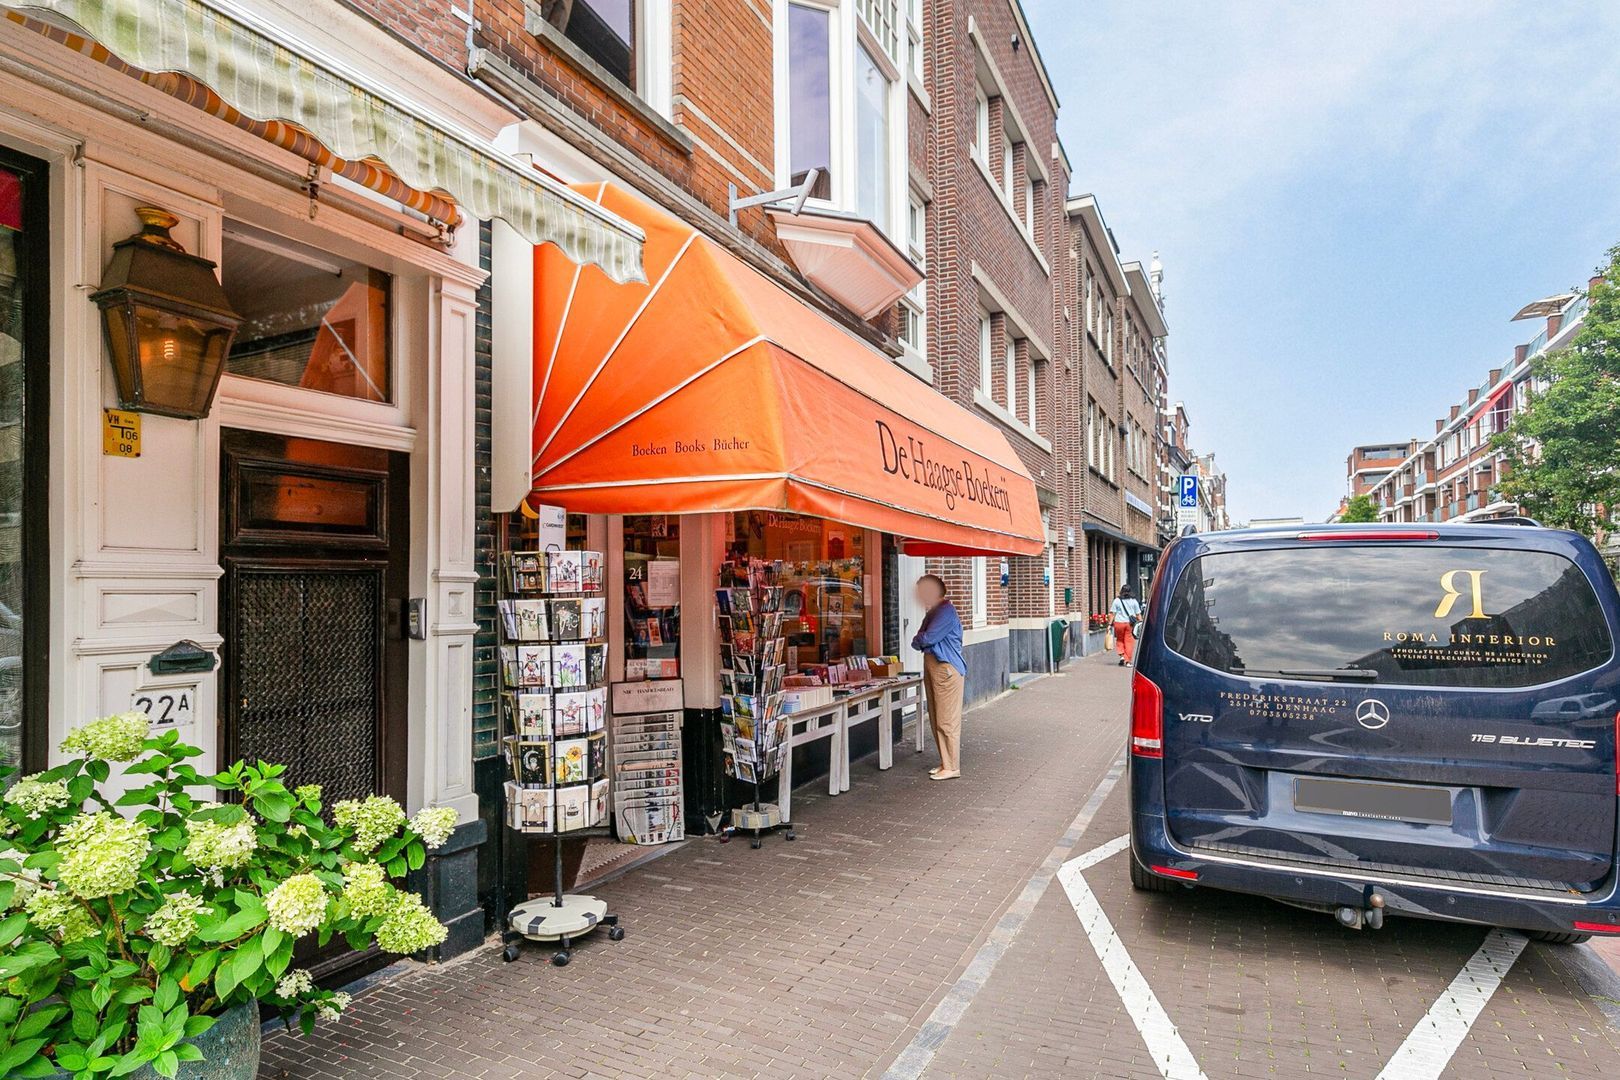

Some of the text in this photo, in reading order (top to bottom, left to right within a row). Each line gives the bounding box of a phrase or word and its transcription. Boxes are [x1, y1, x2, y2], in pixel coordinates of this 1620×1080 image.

[119, 443, 133, 453] 08
[632, 436, 750, 457] Boeken Books Bücher
[875, 419, 1013, 526] De Haagse Boekerij
[629, 566, 642, 580] 24
[1383, 632, 1556, 647] ROMA INTERIOR
[1220, 692, 1347, 707] FREDERIKSTRAAT 22
[1178, 713, 1214, 723] VITO
[1471, 734, 1596, 749] 119 BLUETEC
